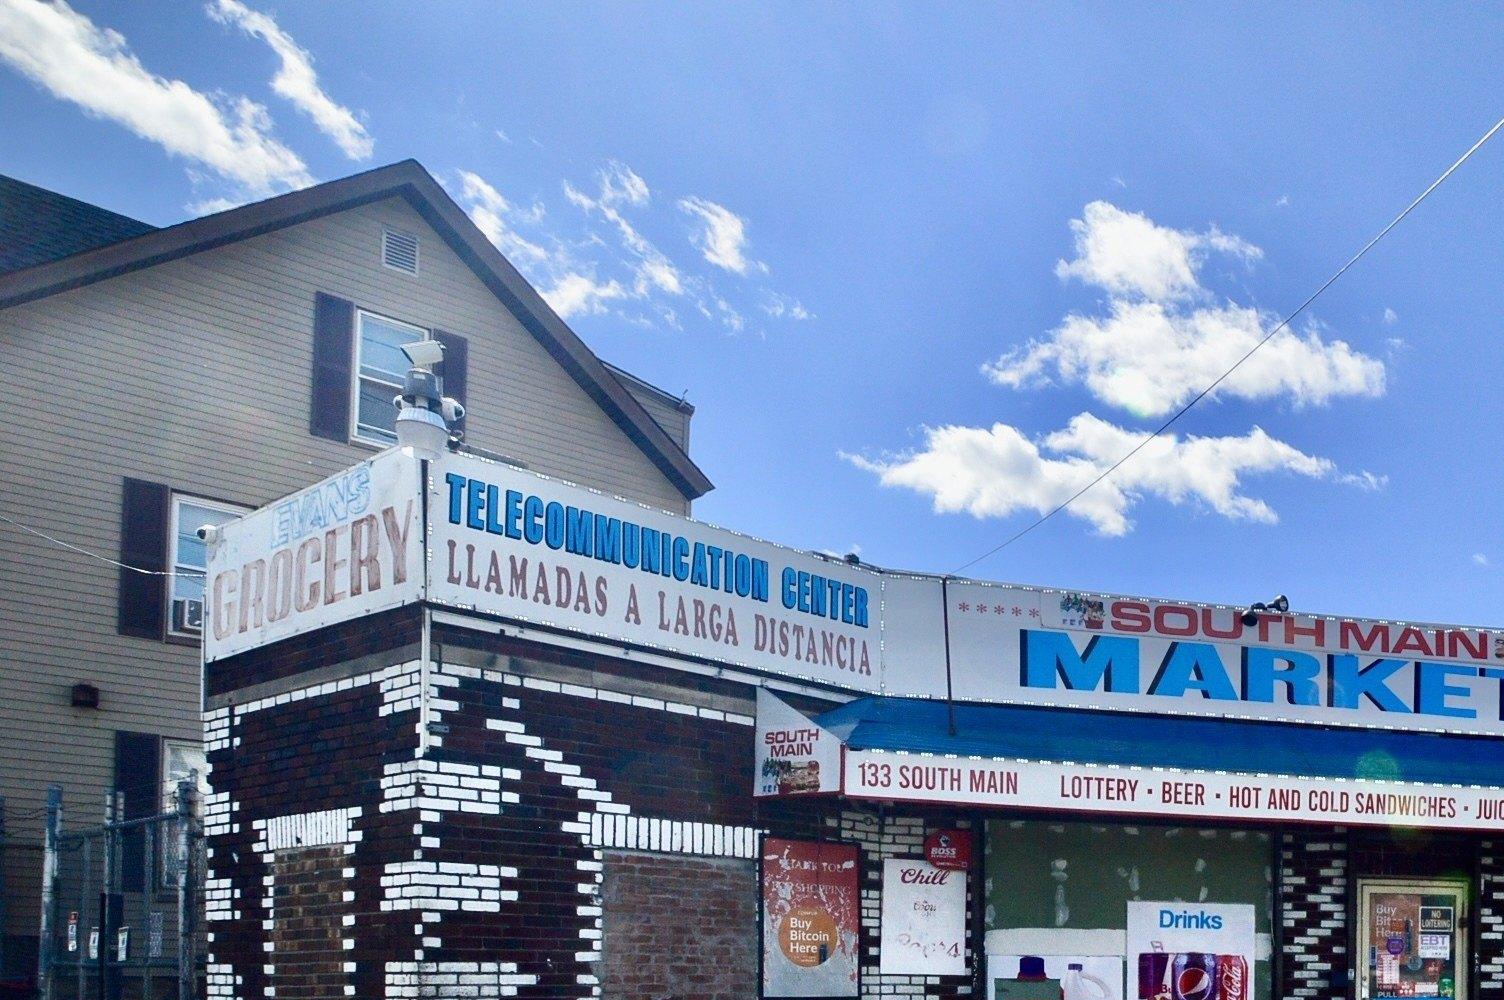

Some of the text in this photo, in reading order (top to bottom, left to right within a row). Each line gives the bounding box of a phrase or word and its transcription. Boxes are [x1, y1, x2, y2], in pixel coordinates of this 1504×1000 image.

[271, 465, 372, 549] EVANS
[446, 472, 869, 629] TELECOMMUNICATION CENTER
[213, 499, 413, 641] GROCERY
[447, 539, 872, 676] LLAMADAS A LARGA DISTANCIA
[1111, 601, 1488, 660] SOUTH MAIN
[765, 729, 819, 744] SOUTH
[771, 743, 813, 757] MAIN
[858, 763, 1018, 794] 133 SOUTH MAIN
[1061, 775, 1138, 801] LOTTERY
[1162, 782, 1206, 806] BEER
[1230, 786, 1457, 818] HOT AND COLD SANDWICHES
[931, 847, 957, 855] BOSS
[901, 868, 950, 886] Chill
[1376, 904, 1397, 915] Buy
[1431, 910, 1442, 919] NO
[790, 917, 812, 929] Buy
[1159, 909, 1223, 930] Drinks
[1421, 919, 1451, 929] LOITERING
[790, 930, 830, 942] Bitcoin
[1420, 935, 1447, 946] EBT
[790, 942, 818, 953] Here
